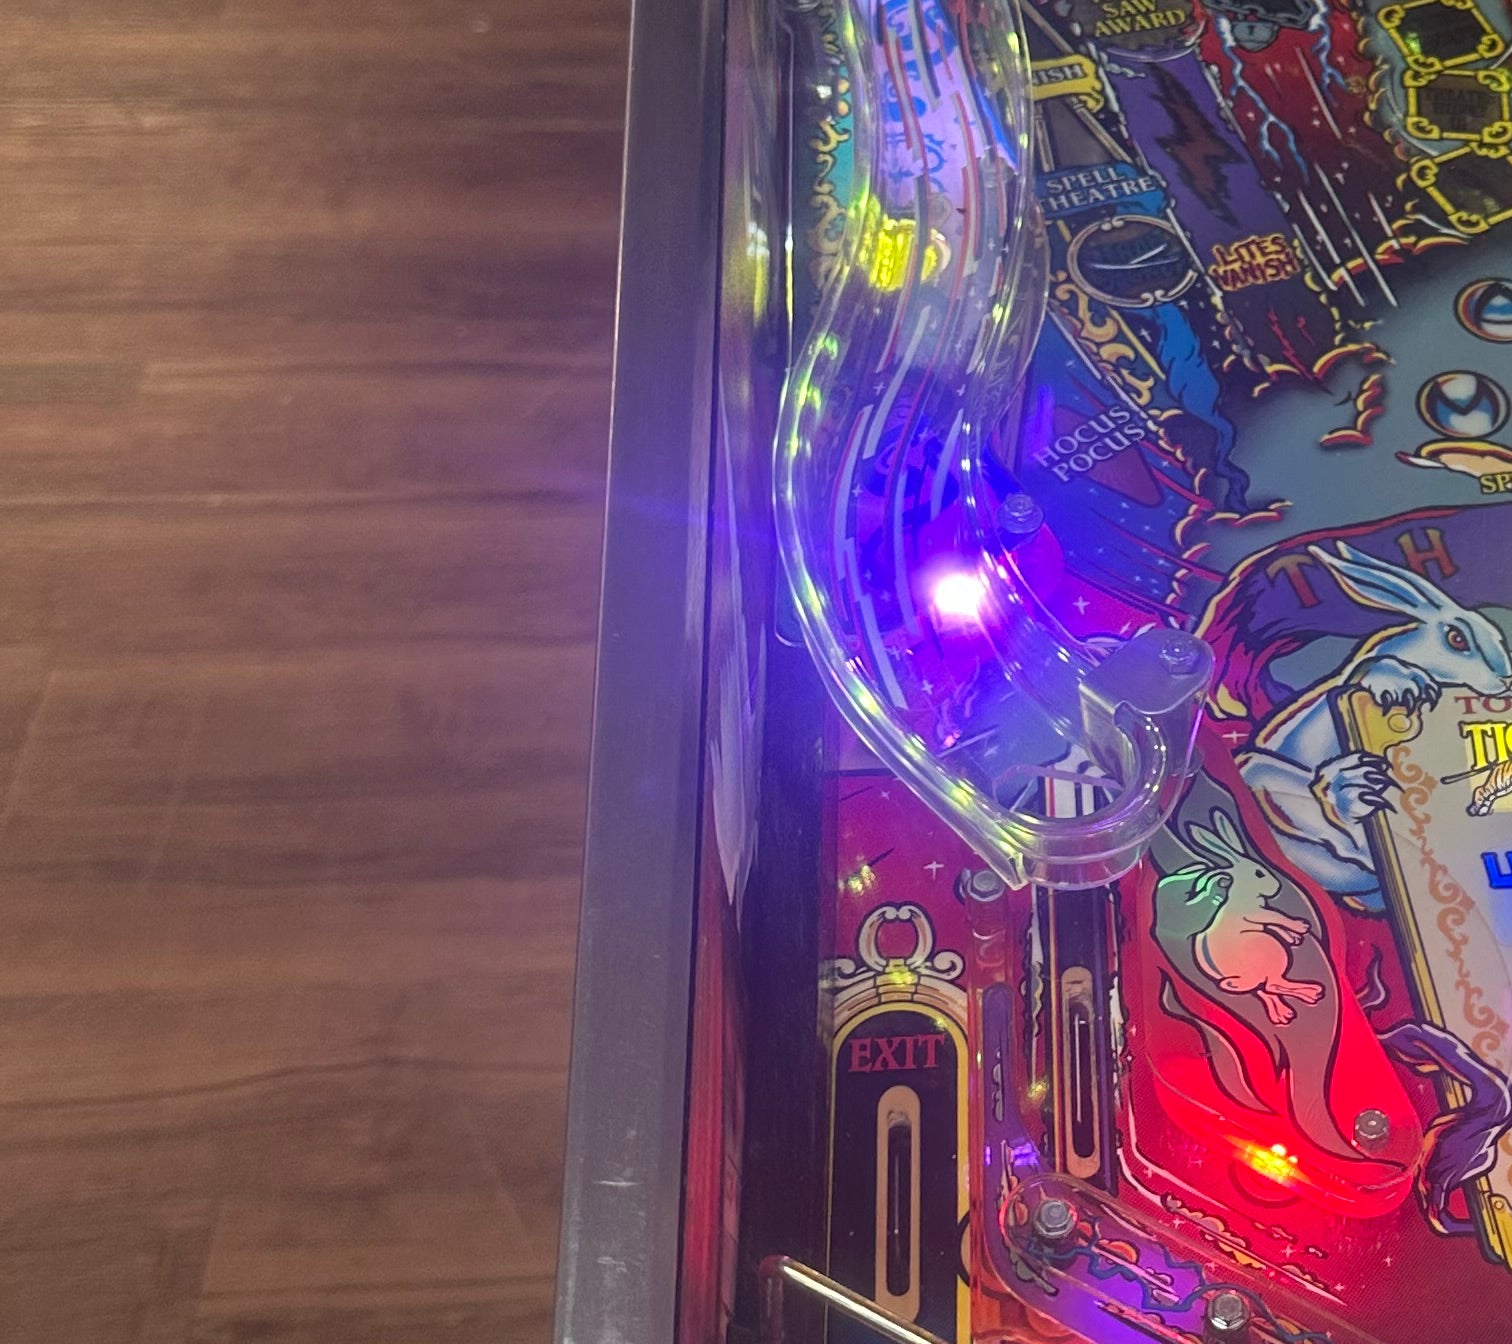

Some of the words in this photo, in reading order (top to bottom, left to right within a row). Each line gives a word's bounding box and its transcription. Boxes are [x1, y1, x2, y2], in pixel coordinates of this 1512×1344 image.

[1095, 8, 1187, 38] AWARD
[1031, 62, 1085, 87] NISH
[1046, 167, 1126, 195] SPELL
[1213, 234, 1288, 265] LITES
[1209, 254, 1300, 291] VANISH
[1034, 403, 1131, 468] HOCUS
[1052, 423, 1145, 482] POCUS
[847, 1031, 947, 1075] EXIT
